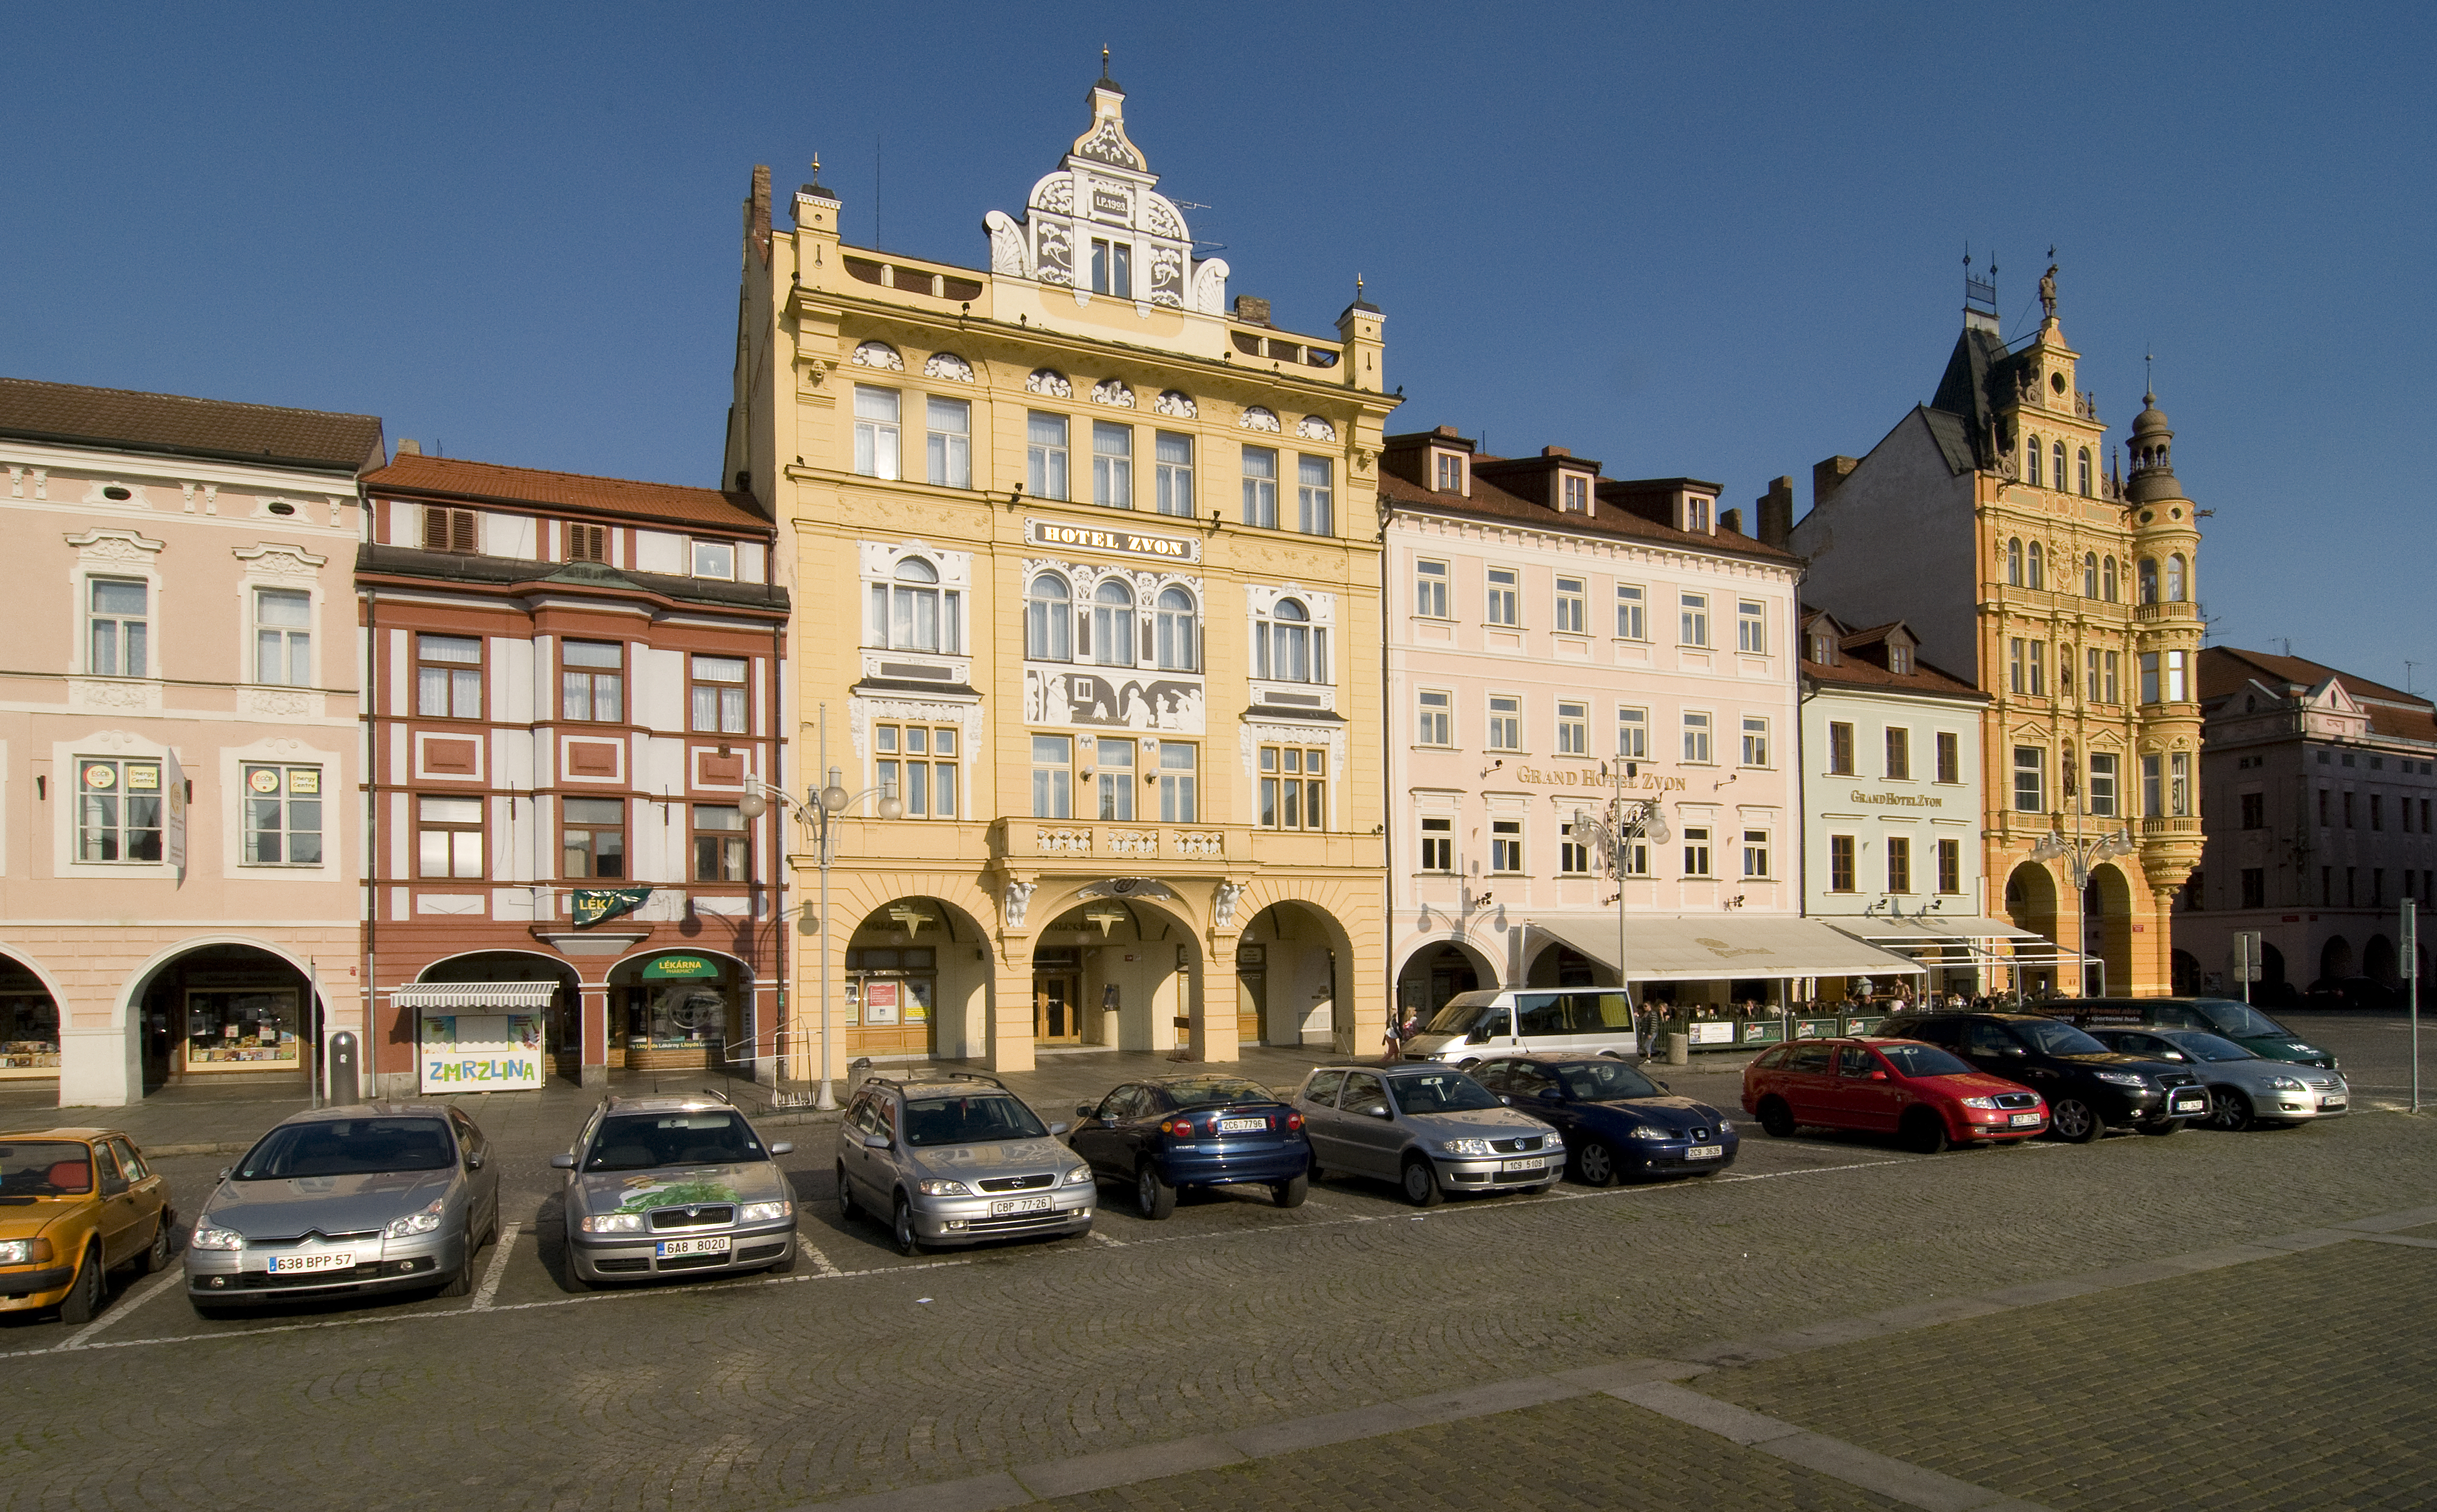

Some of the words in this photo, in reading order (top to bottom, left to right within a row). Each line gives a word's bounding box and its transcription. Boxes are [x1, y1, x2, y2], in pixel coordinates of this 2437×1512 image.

[1044, 527, 1119, 549] HOTEL
[1128, 535, 1183, 556] ZVON
[1517, 765, 1577, 786] GRAND
[1642, 772, 1686, 791] ZVON
[1850, 790, 1886, 804] GRAND
[1886, 792, 1917, 806] HOTEL
[1917, 794, 1942, 807] ZVON
[659, 960, 702, 969] LÉKÁRNA
[430, 1059, 535, 1082] ZMRZLINA
[1224, 1121, 1238, 1130] 2C6
[1243, 1120, 1263, 1129] 7796
[1690, 1149, 1702, 1157] 2C9
[1510, 1161, 1522, 1170] 1C9
[1526, 1159, 1542, 1168] 5109
[997, 1202, 1014, 1212] CBP
[1022, 1199, 1047, 1210] 77-26
[668, 1242, 688, 1253] 6A8
[697, 1239, 725, 1251] 8020
[278, 1258, 303, 1270] 638
[307, 1255, 331, 1268] BPP
[336, 1254, 351, 1265] 57
